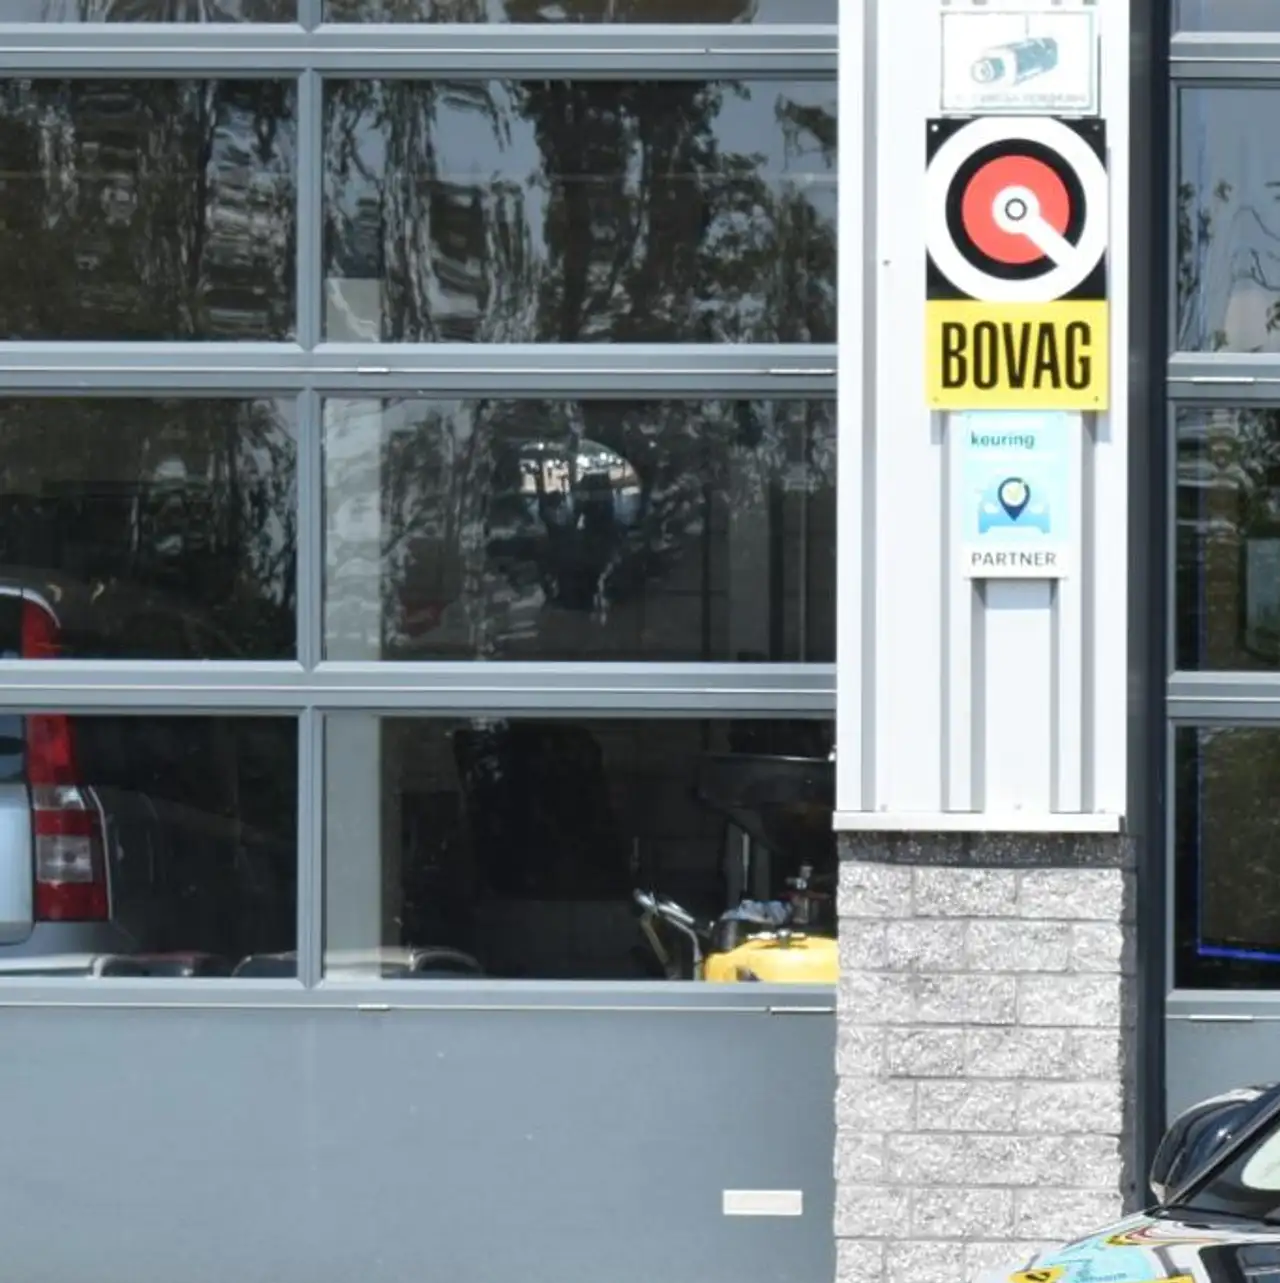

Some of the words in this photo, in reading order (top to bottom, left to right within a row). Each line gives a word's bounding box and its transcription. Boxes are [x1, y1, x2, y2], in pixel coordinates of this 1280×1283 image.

[941, 320, 1092, 390] BOVAG
[971, 430, 1035, 449] keuring
[971, 552, 1057, 566] PARTNER
